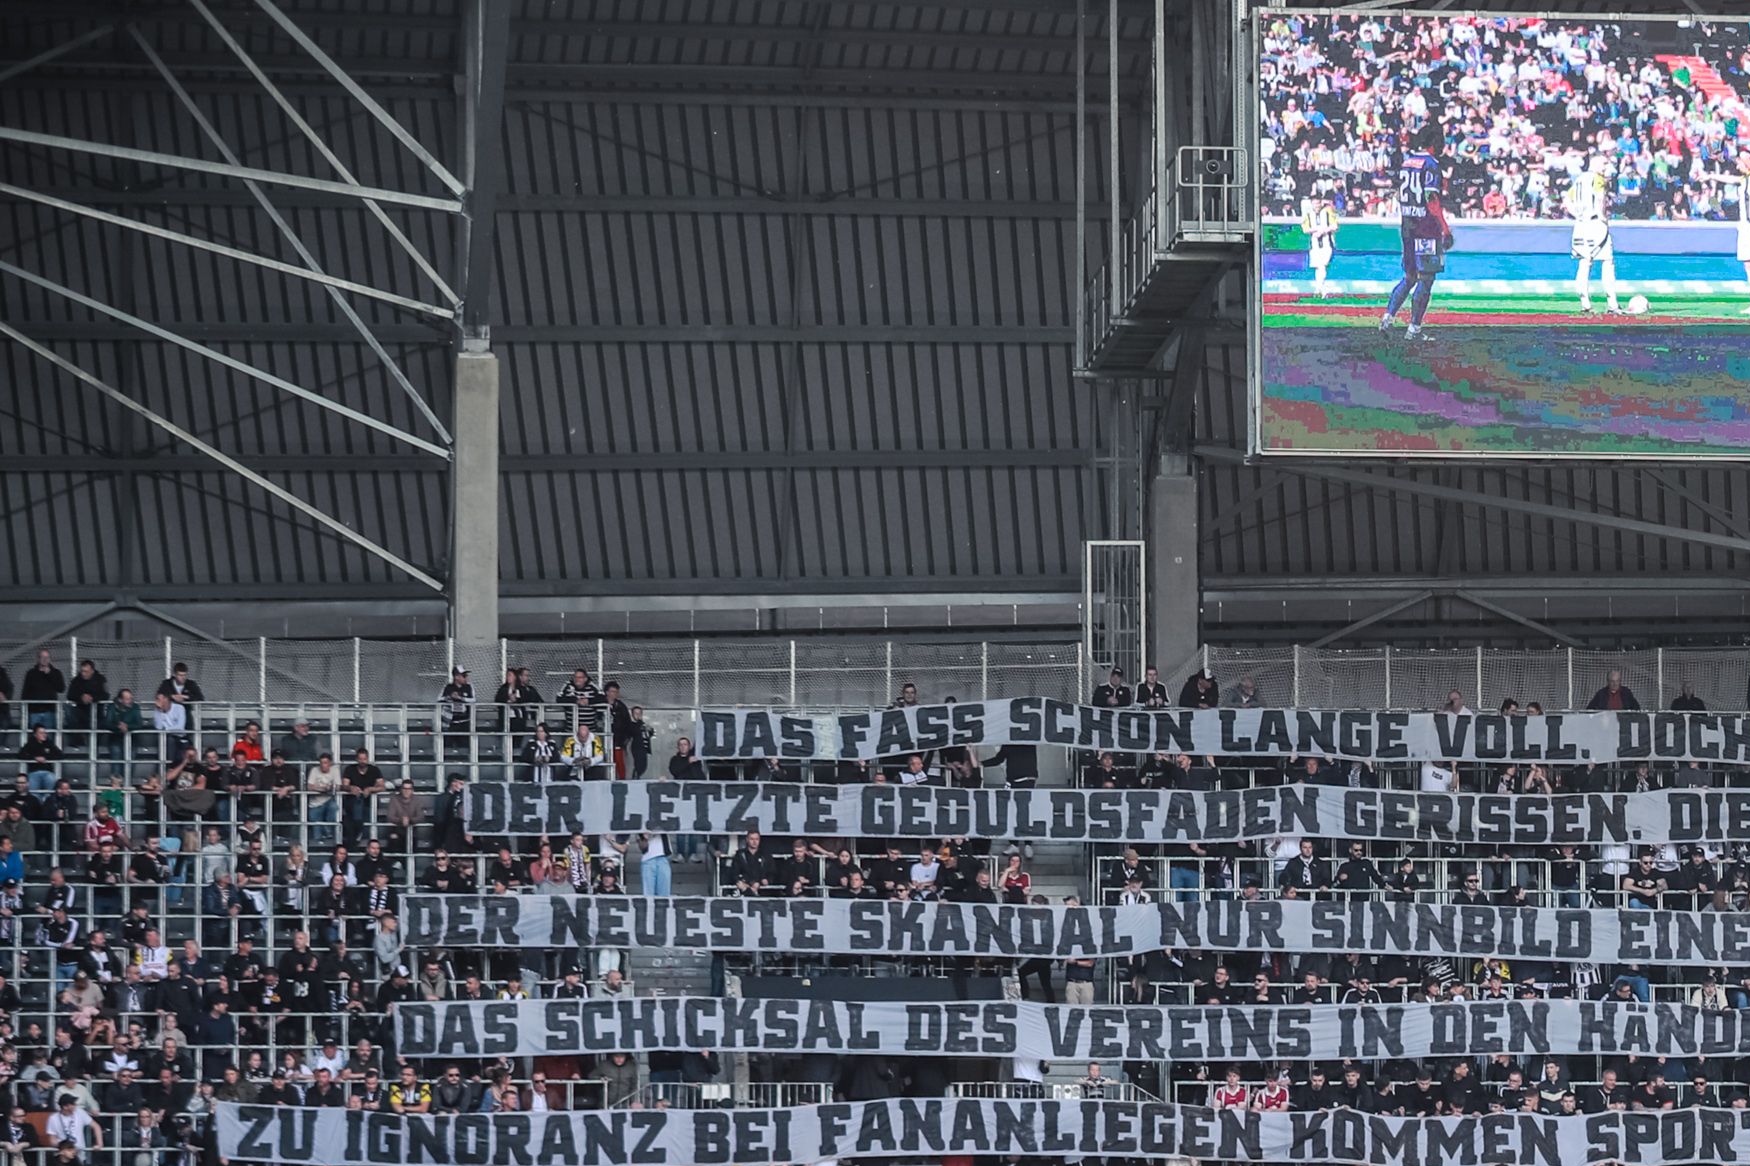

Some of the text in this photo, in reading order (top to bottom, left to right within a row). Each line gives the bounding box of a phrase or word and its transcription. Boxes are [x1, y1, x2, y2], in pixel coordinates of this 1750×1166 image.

[1399, 169, 1423, 204] 24
[702, 711, 814, 758] DAS
[839, 703, 985, 758] FASS
[1009, 698, 1194, 752] SCHON
[1219, 708, 1409, 757] LANGE
[1434, 713, 1590, 759] VOLL.
[469, 783, 581, 833] DER
[611, 779, 836, 834] LETZTE
[861, 783, 1319, 842] GEDULDSFADEN
[1345, 788, 1641, 843] GERISSEN.
[408, 897, 518, 945] DER
[551, 897, 825, 950] NEUESTE
[850, 903, 1132, 957] SKANDAL
[1161, 902, 1282, 950] NUR
[1313, 902, 1591, 958] SINNBILD
[402, 1004, 517, 1053] DAS
[545, 1000, 880, 1052] SCHICKSAL
[906, 1002, 1017, 1052] DES
[1045, 1006, 1311, 1058] VEREINS
[1339, 1008, 1404, 1058] IN
[1432, 1004, 1550, 1054] DEN
[237, 1105, 318, 1159] ZU
[345, 1112, 666, 1166] IGNORANZ
[694, 1110, 792, 1164] BEI
[820, 1099, 1262, 1158] FANANLIEGEN
